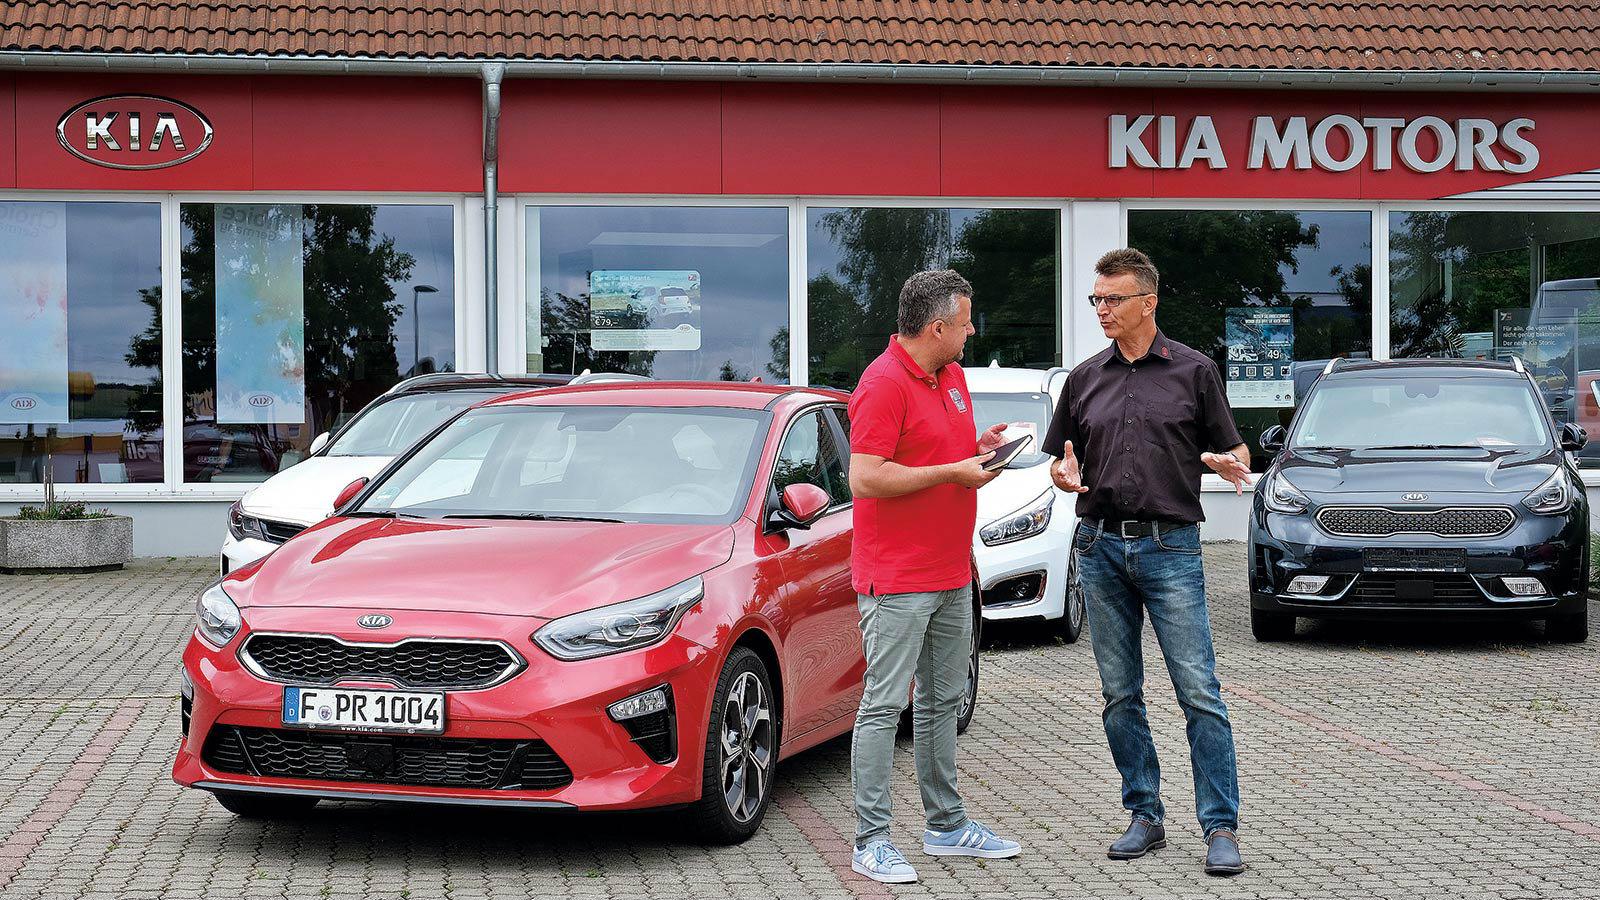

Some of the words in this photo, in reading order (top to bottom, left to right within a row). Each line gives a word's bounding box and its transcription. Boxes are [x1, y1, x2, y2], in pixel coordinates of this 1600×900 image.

[85, 112, 186, 151] KIA
[1108, 115, 1228, 169] KIA
[1247, 114, 1540, 174] MOTORS
[363, 615, 387, 625] KIA
[288, 708, 295, 717] D
[301, 692, 318, 719] F
[335, 693, 368, 722] PR
[374, 695, 440, 726] 1004
[341, 725, 384, 733] www.kia.com
